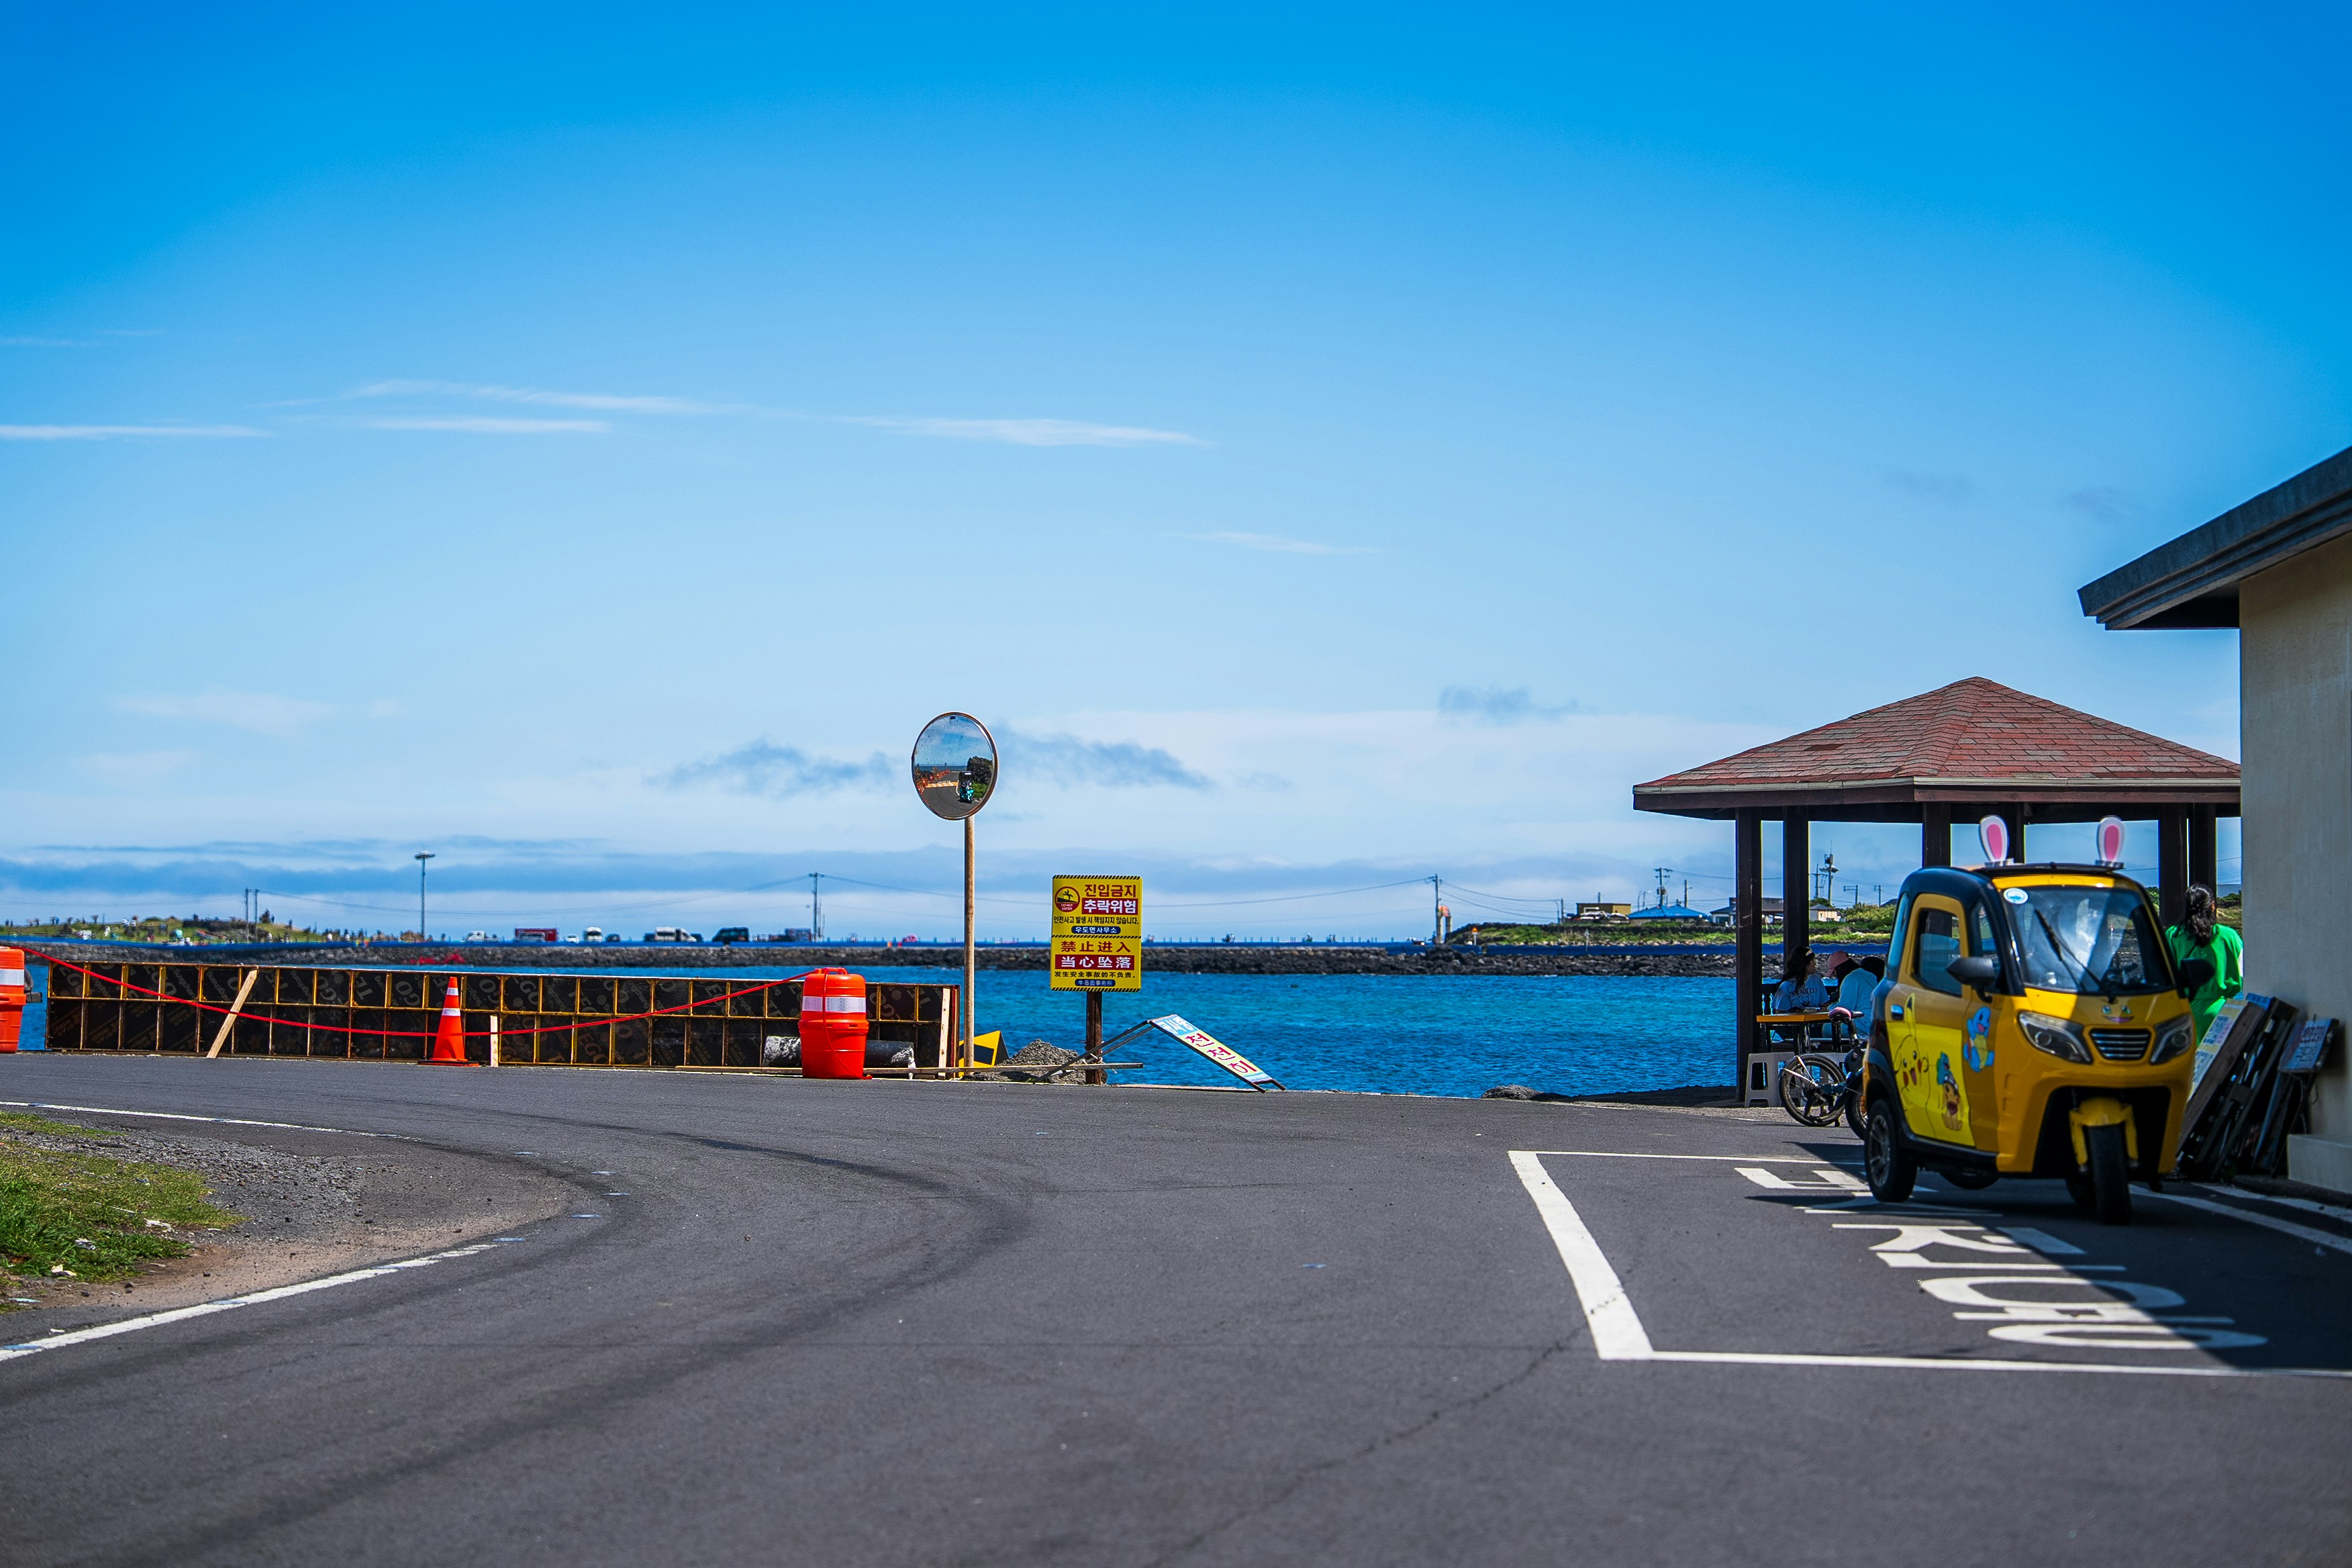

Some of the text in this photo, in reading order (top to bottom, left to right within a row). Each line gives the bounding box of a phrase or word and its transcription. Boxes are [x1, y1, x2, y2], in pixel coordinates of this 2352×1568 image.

[1084, 884, 1136, 897] 진입금지
[1083, 899, 1136, 914] 추락위험
[1061, 940, 1131, 952] 禁止进入
[1061, 956, 1131, 968] 当心坠落
[1185, 1033, 1257, 1073] 천천히
